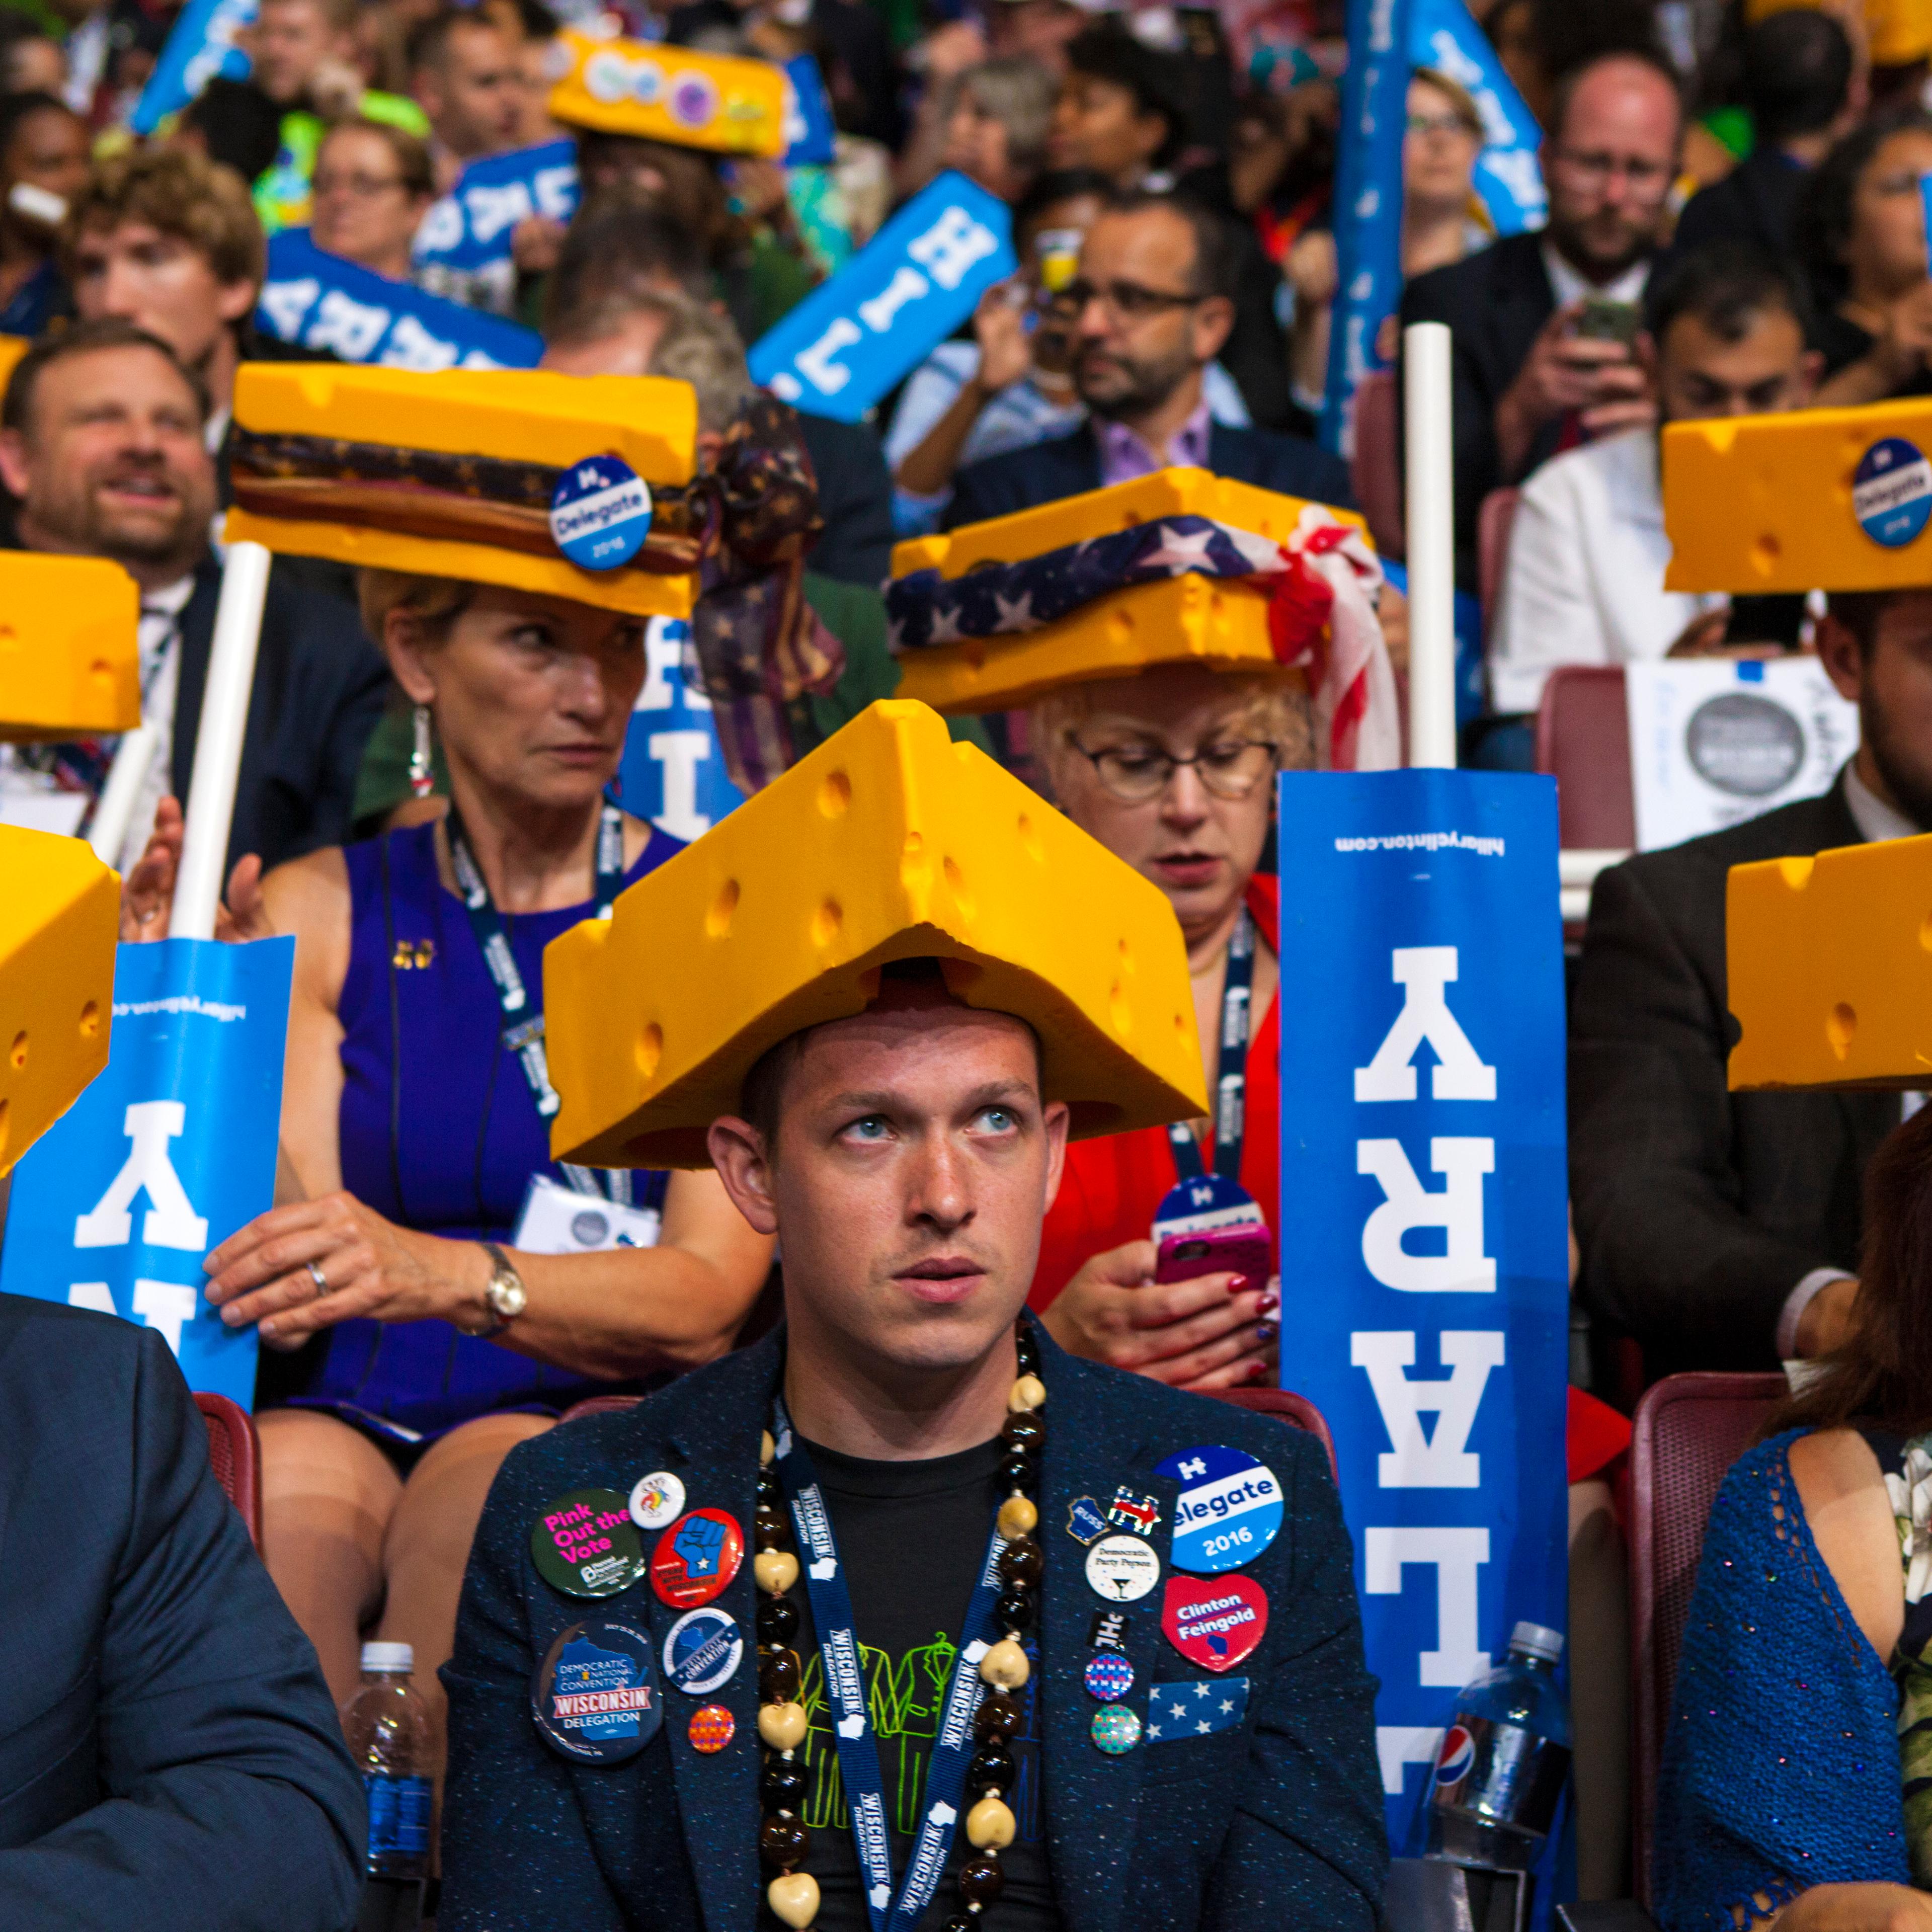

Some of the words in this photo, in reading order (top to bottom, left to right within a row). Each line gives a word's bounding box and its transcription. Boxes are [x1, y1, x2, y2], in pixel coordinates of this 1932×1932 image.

[557, 494, 641, 535] Delegate
[1335, 830, 1505, 857] hillaryclinton.com
[113, 995, 247, 1022] hillaryclinton.co
[544, 1503, 594, 1532] Pink
[1074, 1506, 1105, 1530] RUSS
[1175, 1480, 1273, 1526] elegate
[553, 1522, 597, 1547] Out
[596, 1509, 630, 1530] the
[800, 1487, 833, 1556] WISCONSIN
[559, 1538, 612, 1564] Vote
[1202, 1526, 1253, 1557] 2016
[1177, 1594, 1242, 1620] Clinton
[1177, 1607, 1256, 1641] Feingold
[559, 1659, 627, 1674] DEMOCRATIC
[590, 1668, 634, 1678] NATIONAL
[823, 1643, 840, 1698] DELEGATION
[833, 1633, 862, 1711] WISCONSIN
[561, 1677, 629, 1691] CONVENTION
[556, 1689, 647, 1715] WISCONSIN
[943, 1666, 977, 1745] WISCONSIN
[564, 1712, 640, 1729] DELEGATION
[854, 1806, 869, 1865] DELEGATION
[862, 1796, 888, 1881] WISCONSIN
[901, 1826, 943, 1913] WISCONSIN
[920, 1848, 948, 1906] DELEGATION
